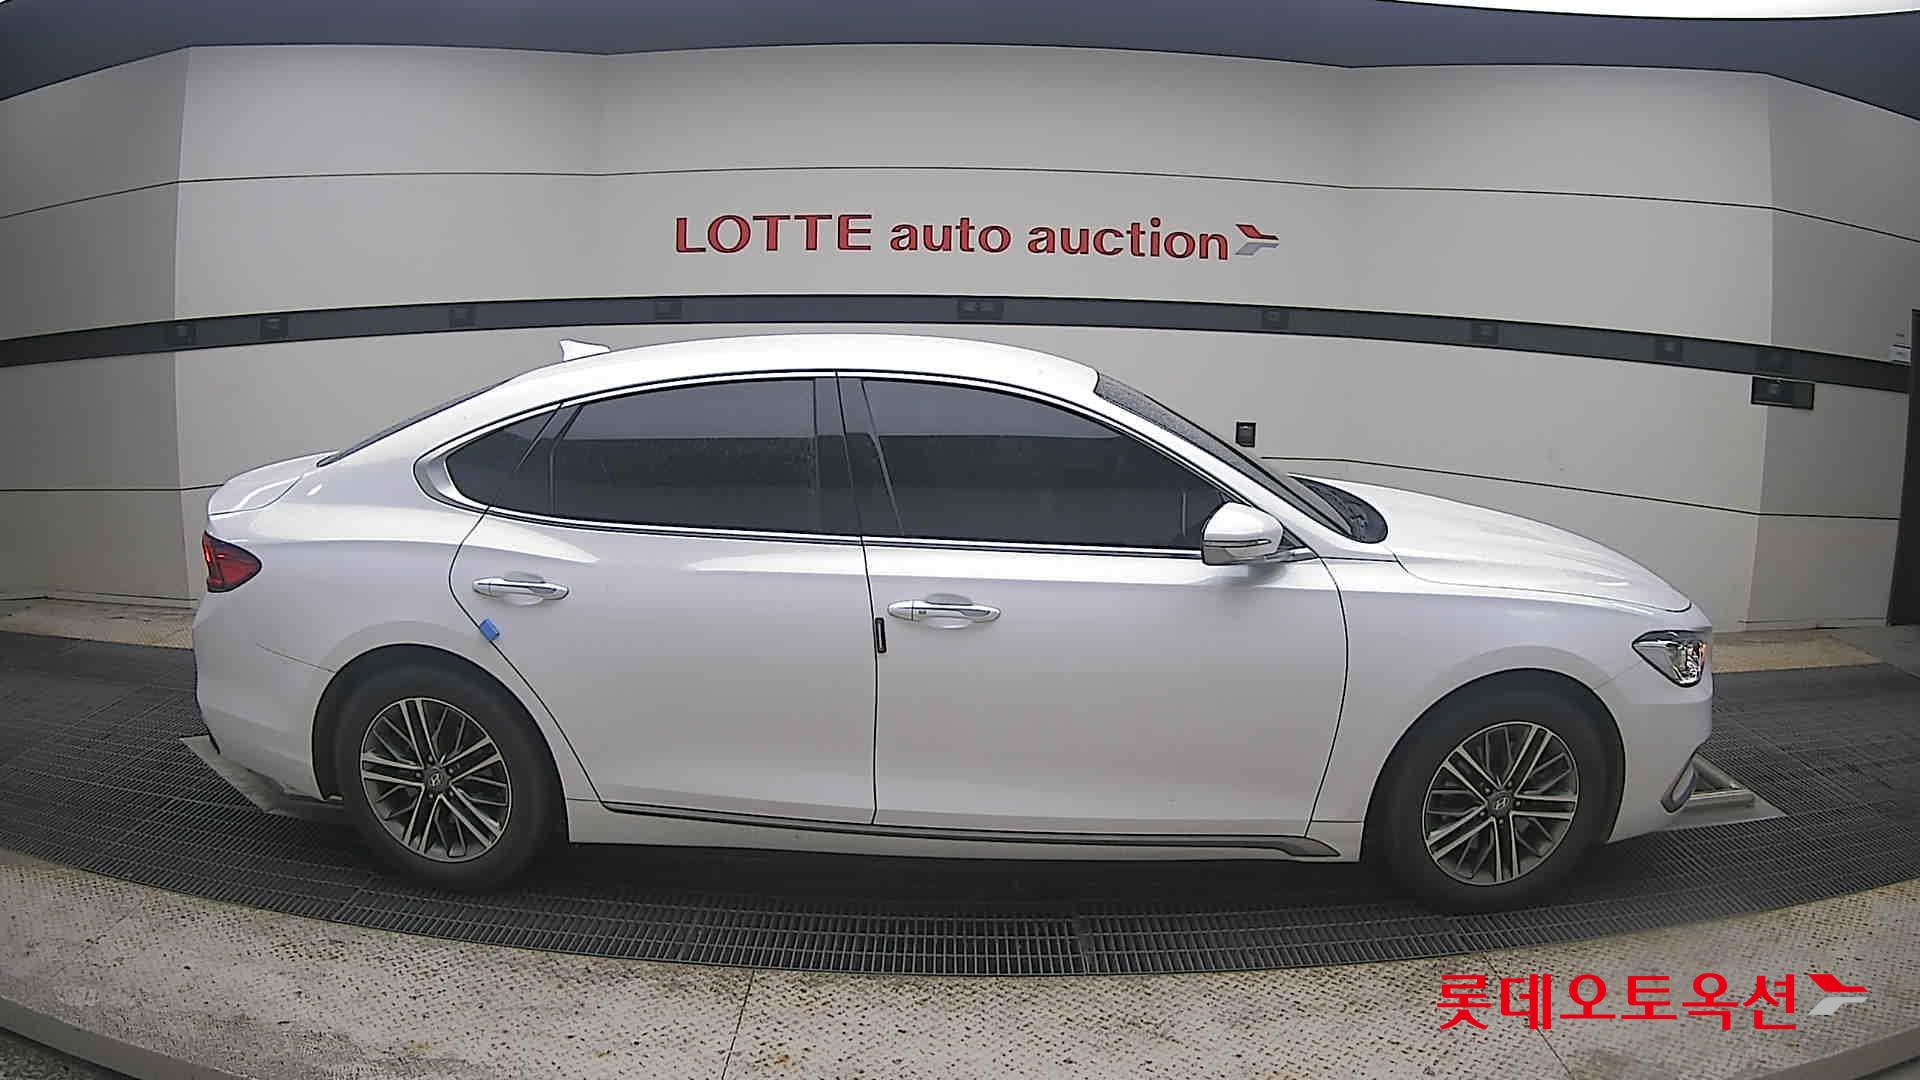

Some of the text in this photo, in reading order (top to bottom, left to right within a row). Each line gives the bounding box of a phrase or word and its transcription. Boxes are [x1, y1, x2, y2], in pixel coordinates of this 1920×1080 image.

[675, 214, 1229, 260] LOTTE auto auction
